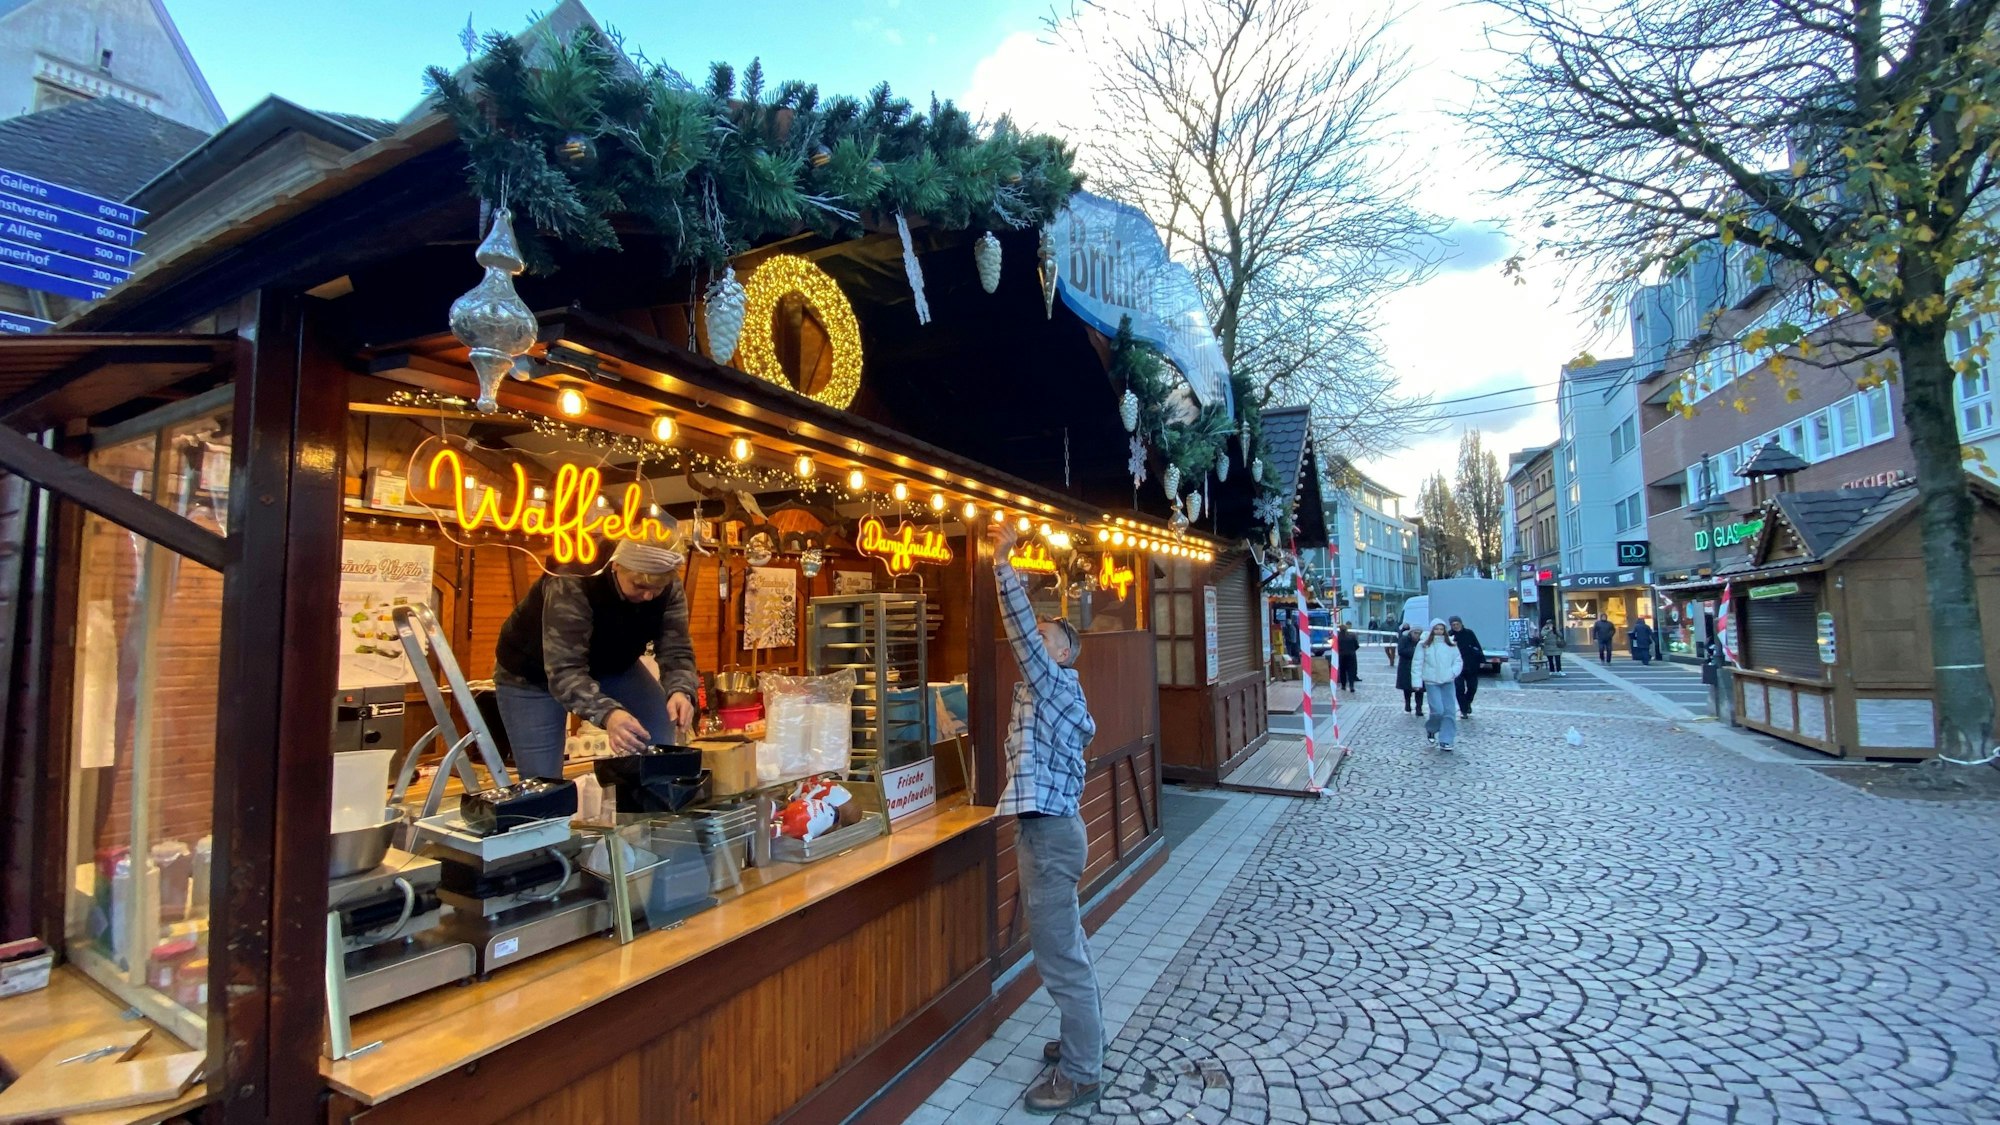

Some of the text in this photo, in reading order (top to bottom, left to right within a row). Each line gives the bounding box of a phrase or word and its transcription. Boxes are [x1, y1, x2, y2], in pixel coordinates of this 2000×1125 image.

[0, 174, 129, 221] Galerie 600 m
[7, 223, 42, 241] Allee
[95, 246, 113, 260] 500
[115, 253, 125, 263] m
[96, 226, 115, 239] 600
[117, 232, 127, 242] m
[92, 269, 111, 281] 300
[428, 448, 672, 565] Waffeln
[862, 519, 951, 571] Dampfnudeln
[1578, 576, 1610, 585] OPTIC
[897, 770, 925, 790] Frische
